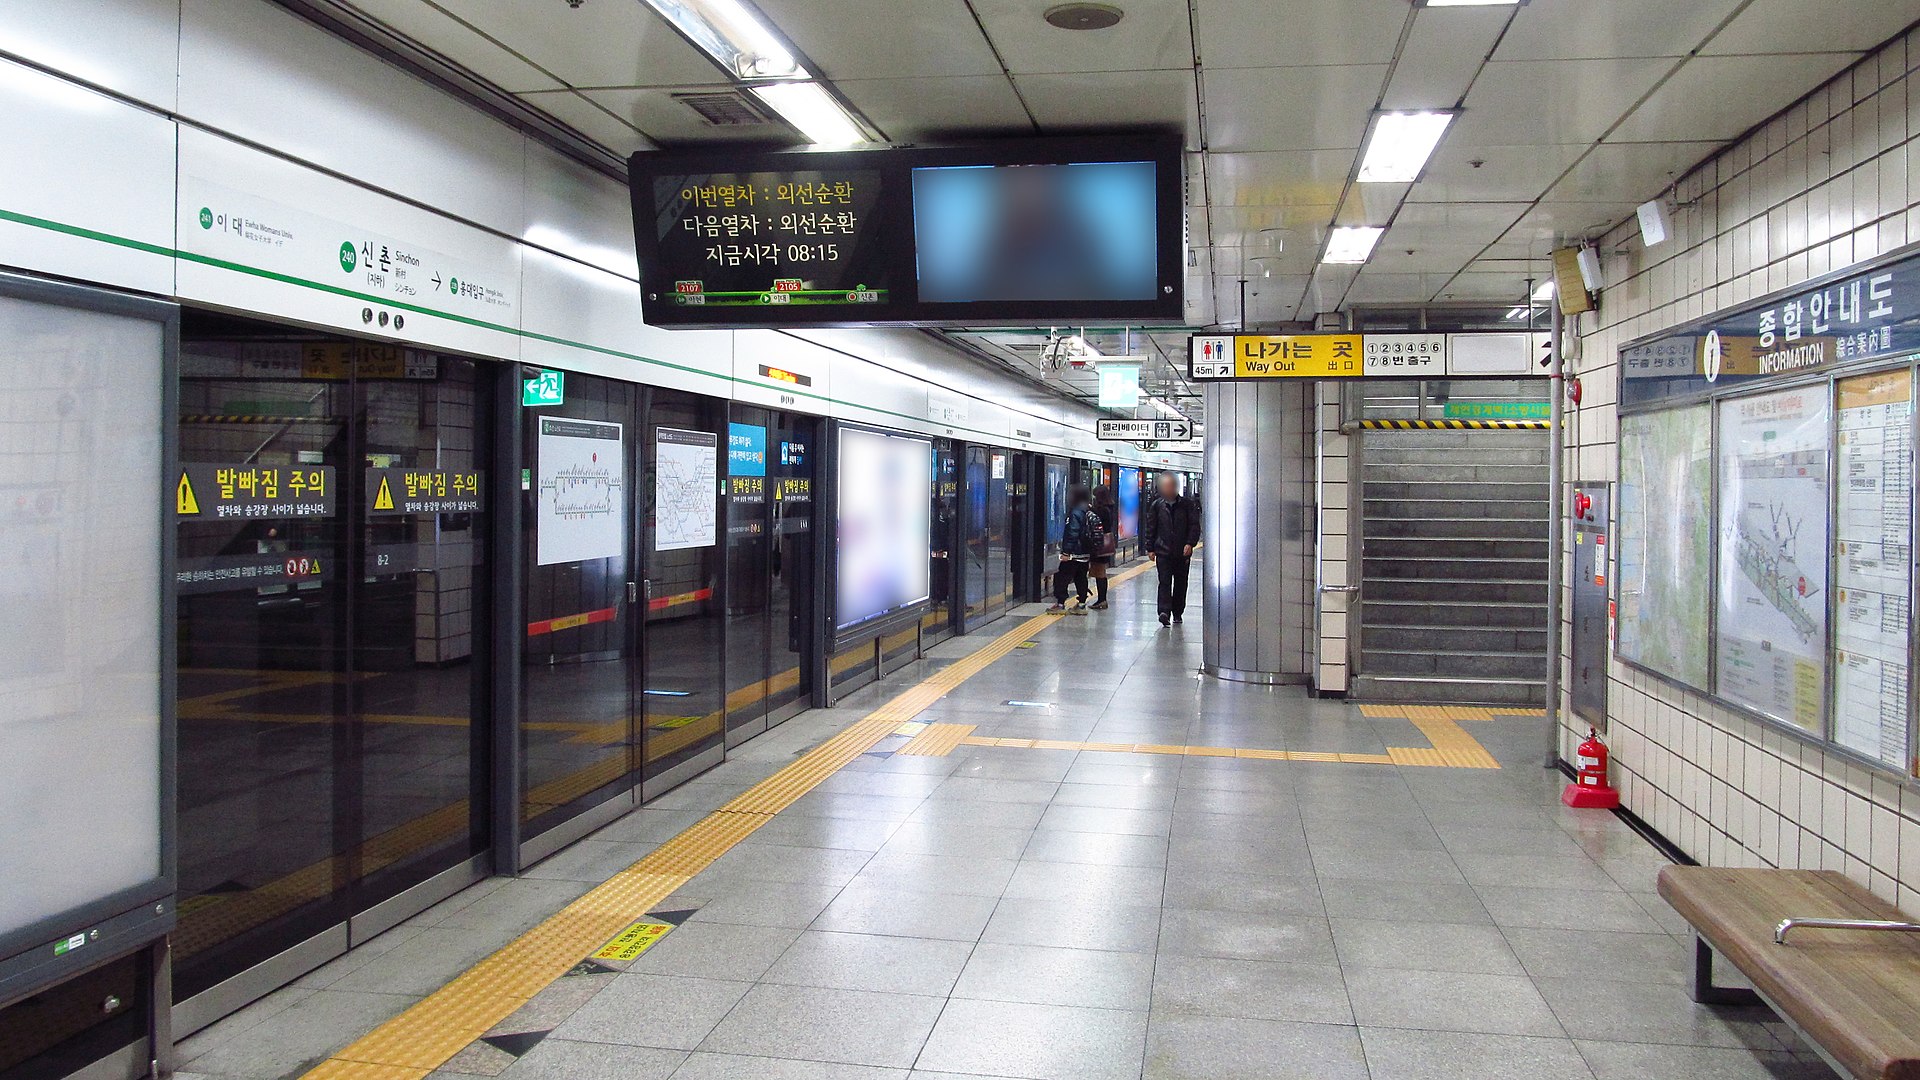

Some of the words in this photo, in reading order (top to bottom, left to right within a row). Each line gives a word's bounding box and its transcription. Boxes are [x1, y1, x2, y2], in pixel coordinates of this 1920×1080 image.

[681, 184, 756, 208] 이번열차
[776, 181, 854, 205] 외선순환
[682, 213, 760, 238] 다음열차
[779, 211, 858, 236] 외선순환
[341, 250, 355, 264] 240
[395, 250, 420, 267] Sinchon
[705, 243, 781, 267] 지금시각
[787, 243, 839, 263] 08:15
[366, 271, 386, 288] (지하)
[778, 282, 799, 292] 2105
[459, 281, 485, 300] 홍대입구
[680, 284, 699, 293] 2107
[1758, 272, 1894, 348] 종합안내도
[1244, 341, 1313, 360] 나가는
[1332, 341, 1353, 359] 곳
[1758, 341, 1825, 375] INFORMATION
[1194, 366, 1213, 376] 45m
[1245, 361, 1270, 374] Way
[1273, 361, 1296, 372] Out
[1102, 423, 1150, 432] 엘리베이터
[216, 467, 280, 499] 발빠짐
[288, 469, 326, 498] 주의
[404, 472, 447, 498] 발빠짐
[452, 473, 479, 496] 주의
[216, 504, 241, 517] 열차와
[244, 504, 269, 517] 승강장
[271, 503, 294, 516] 사이가
[296, 503, 328, 516] 넓습니다.
[377, 554, 389, 566] 8-2
